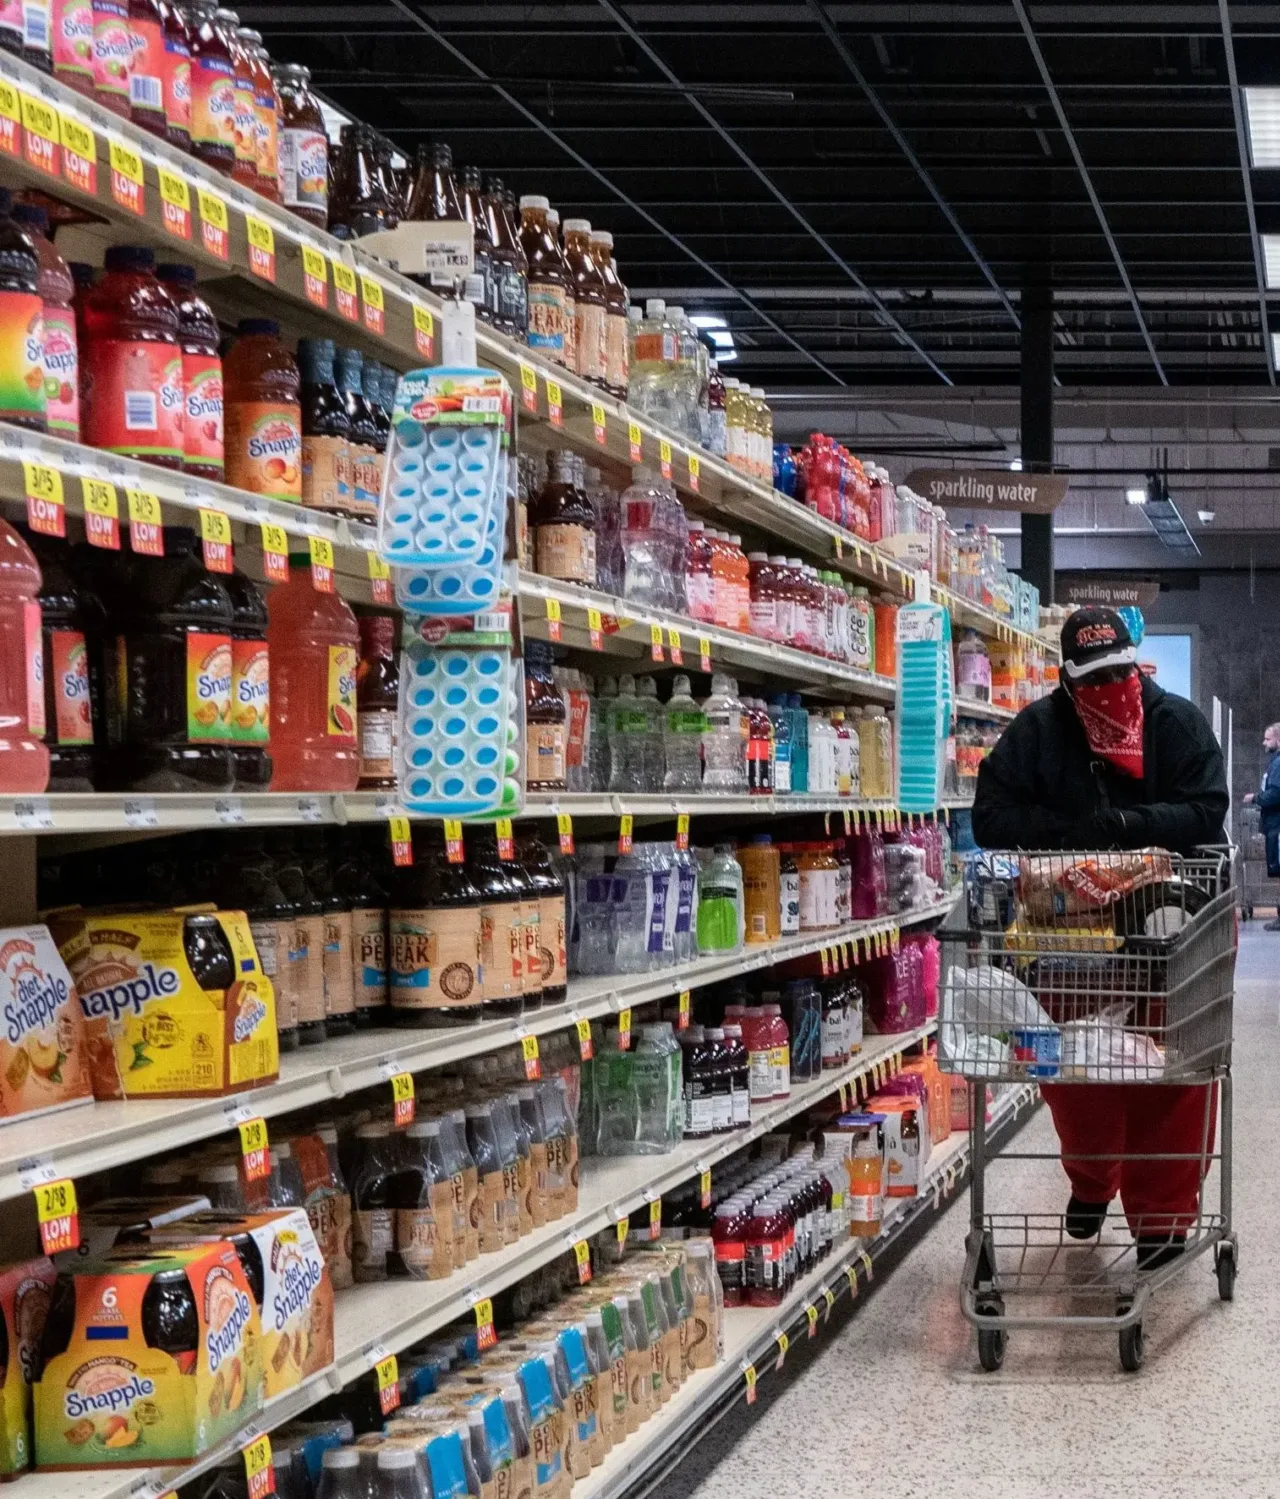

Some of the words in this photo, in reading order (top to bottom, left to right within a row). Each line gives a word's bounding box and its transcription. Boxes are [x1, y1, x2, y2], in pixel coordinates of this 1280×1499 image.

[27, 132, 53, 158] LOW
[64, 148, 90, 176] LOW
[114, 170, 139, 198] LOW
[930, 478, 993, 503] sparkling
[998, 483, 1038, 502] water
[30, 499, 58, 521] LOW
[89, 513, 113, 534] LOW
[134, 521, 158, 541] LOW
[205, 541, 227, 560] LOW
[266, 553, 285, 569] LOW
[313, 565, 330, 581] LOW
[1069, 585, 1109, 601] sparkling
[1112, 587, 1139, 601] water
[18, 975, 42, 1002] diet
[4, 974, 68, 1043] Snapple
[235, 1001, 267, 1041] Snapple
[246, 1152, 265, 1170] LOW
[44, 1185, 67, 1211] 2/$8
[44, 1217, 71, 1238] LOW
[284, 1263, 301, 1291] diet
[102, 1286, 117, 1308] 6
[274, 1258, 320, 1330] Snapple
[208, 1290, 250, 1371] Snapple
[479, 1325, 492, 1339] LOW
[66, 1377, 154, 1417] Snapple
[381, 1386, 397, 1404] LOW
[251, 1469, 270, 1491] LOW
